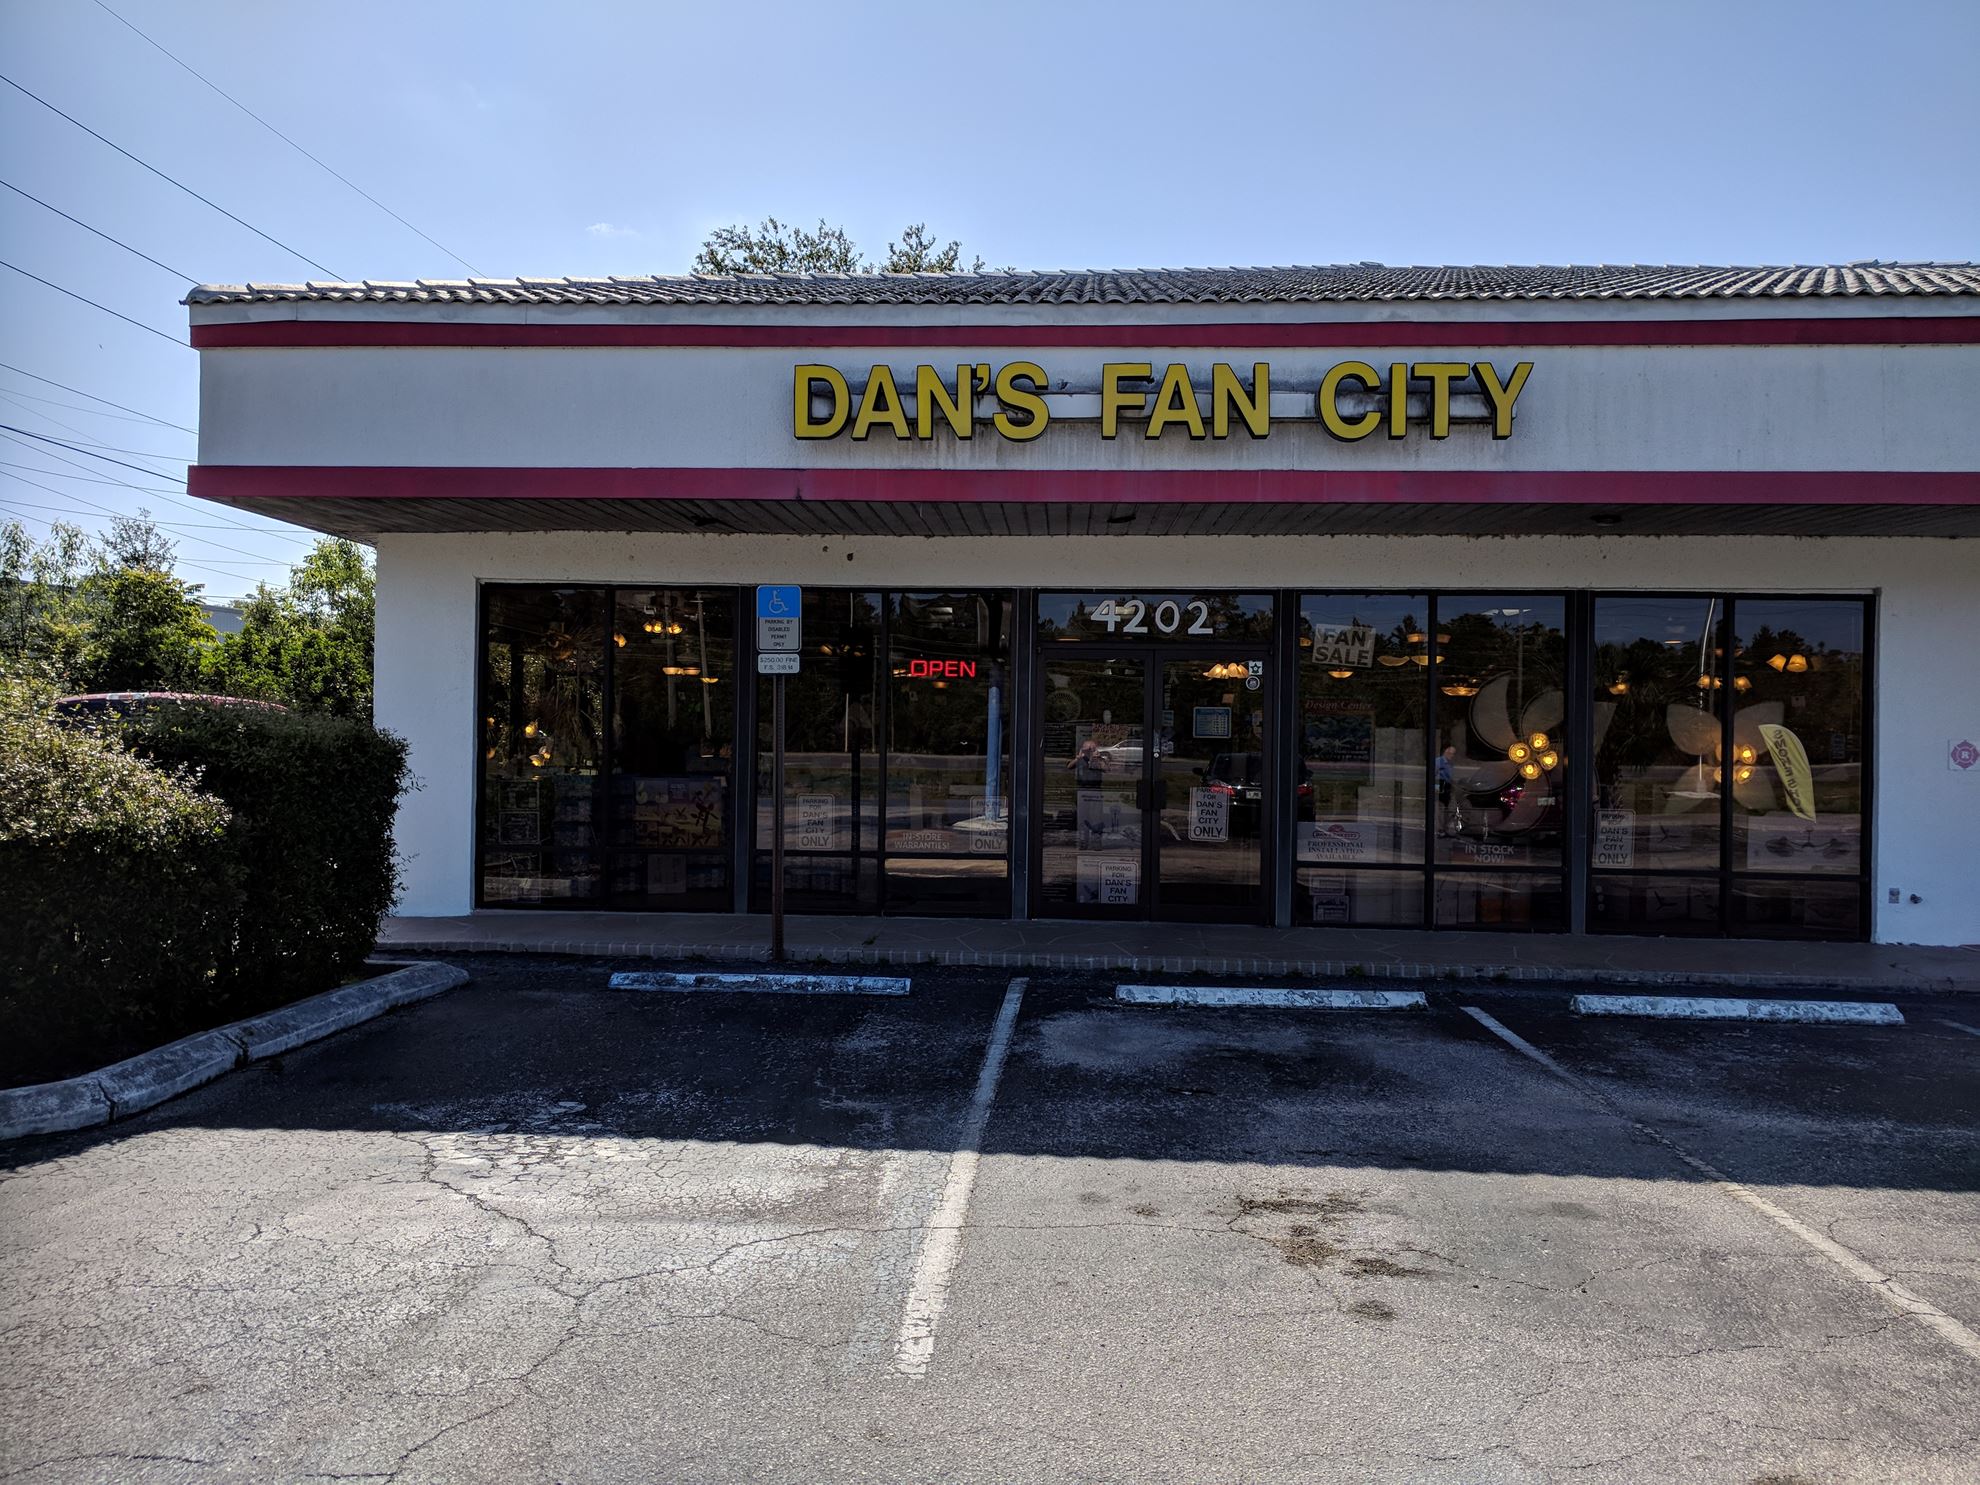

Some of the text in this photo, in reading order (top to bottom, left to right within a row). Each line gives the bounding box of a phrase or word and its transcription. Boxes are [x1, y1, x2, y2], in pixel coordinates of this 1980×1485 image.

[794, 361, 1535, 442] DAN'S FAN CITY
[1091, 599, 1214, 635] 4202
[1323, 628, 1366, 646] FAN
[1314, 646, 1370, 666] SALE
[910, 659, 977, 678] OPEN
[1196, 801, 1223, 809] DAN'S
[802, 811, 828, 819] DAN'S
[902, 832, 942, 841] IN-STORE
[1193, 826, 1223, 838] ONLY
[1601, 827, 1629, 835] DAN'S
[801, 835, 830, 847] ONLY
[894, 841, 951, 850] WARRANTIES!
[974, 838, 1004, 850] ONLY
[1465, 844, 1515, 855] IN STOCK
[1603, 843, 1624, 851] CITY
[1474, 854, 1505, 864] NOW!
[1598, 853, 1629, 864] ONLY
[1105, 879, 1132, 887] DAN'S
[1107, 895, 1128, 903] CITY
